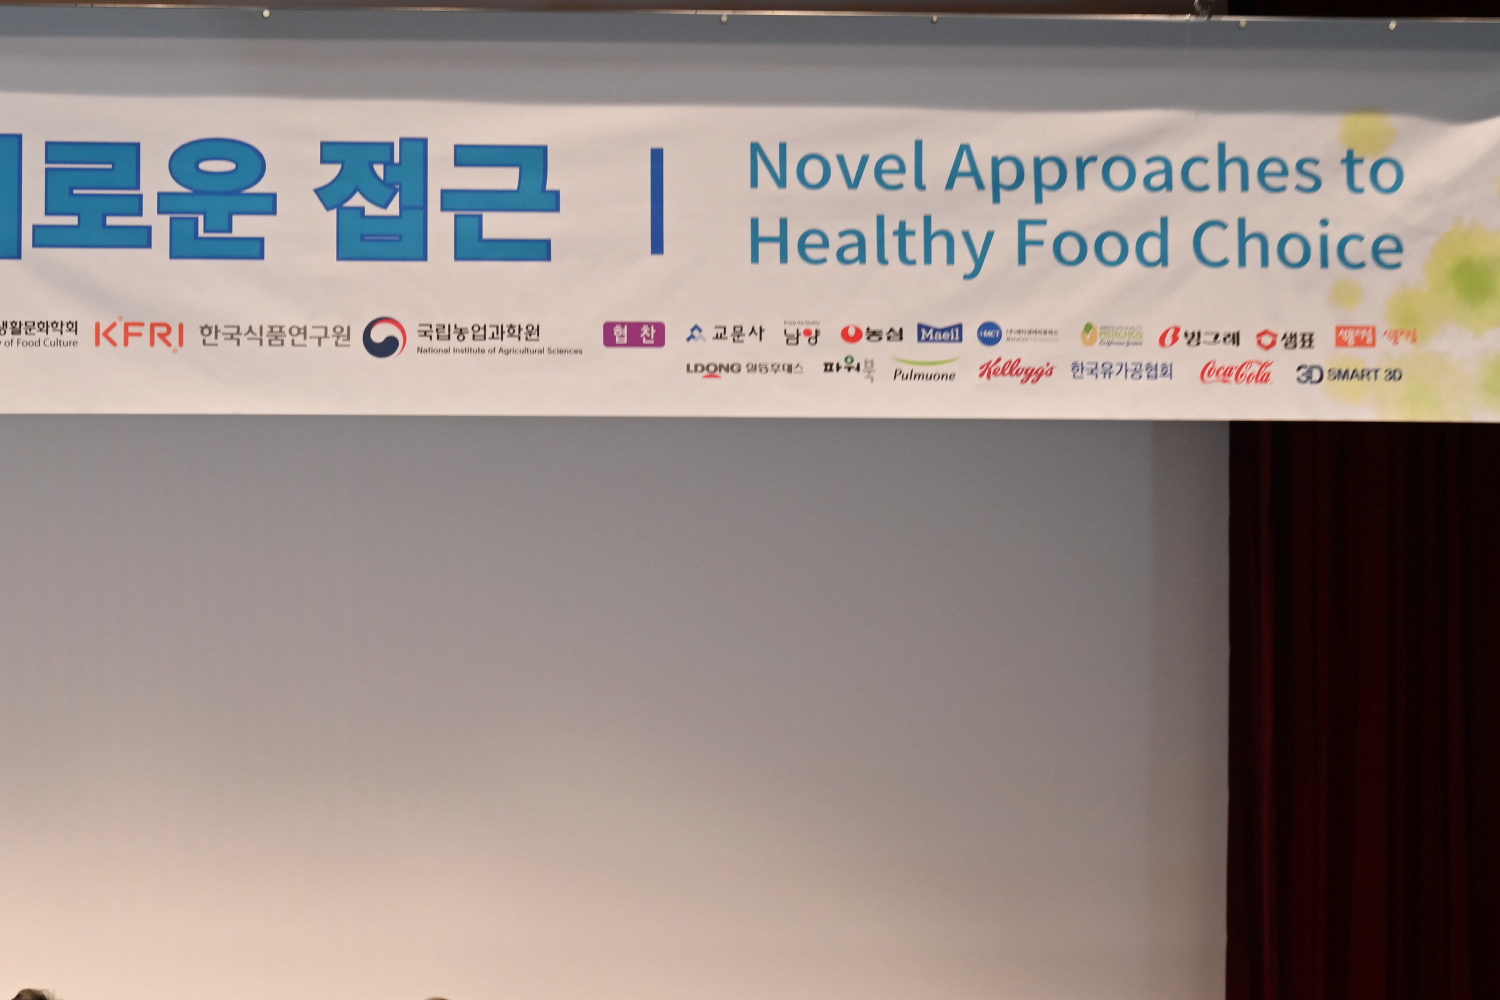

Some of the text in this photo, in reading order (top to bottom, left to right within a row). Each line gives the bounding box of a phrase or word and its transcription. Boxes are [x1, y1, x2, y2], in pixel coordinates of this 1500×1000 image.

[750, 139, 1405, 204] Novel Approaches to
[312, 137, 560, 261] 접근
[751, 214, 1404, 280] Healthy Food Choice
[95, 321, 184, 347] KFRI
[199, 323, 351, 348] 한국식품연구원
[417, 323, 540, 342] 국립농업과학원
[712, 325, 765, 343] 교문사
[782, 327, 822, 348] 남양
[865, 327, 904, 345] 농심
[919, 326, 962, 343] Maeil
[1183, 330, 1241, 347] 빙그레
[1281, 332, 1314, 350] 샘표
[3, 337, 14, 347] of
[16, 337, 41, 348] Food
[42, 337, 78, 348] Culture
[416, 346, 583, 356] National Institute of Agricultural Sciences
[893, 368, 956, 381] Pulmuone
[978, 356, 1055, 385] Kellogg's
[1070, 361, 1173, 381] 한국유가공협회
[1327, 368, 1379, 381] SMART
[1384, 368, 1403, 381] 3D
